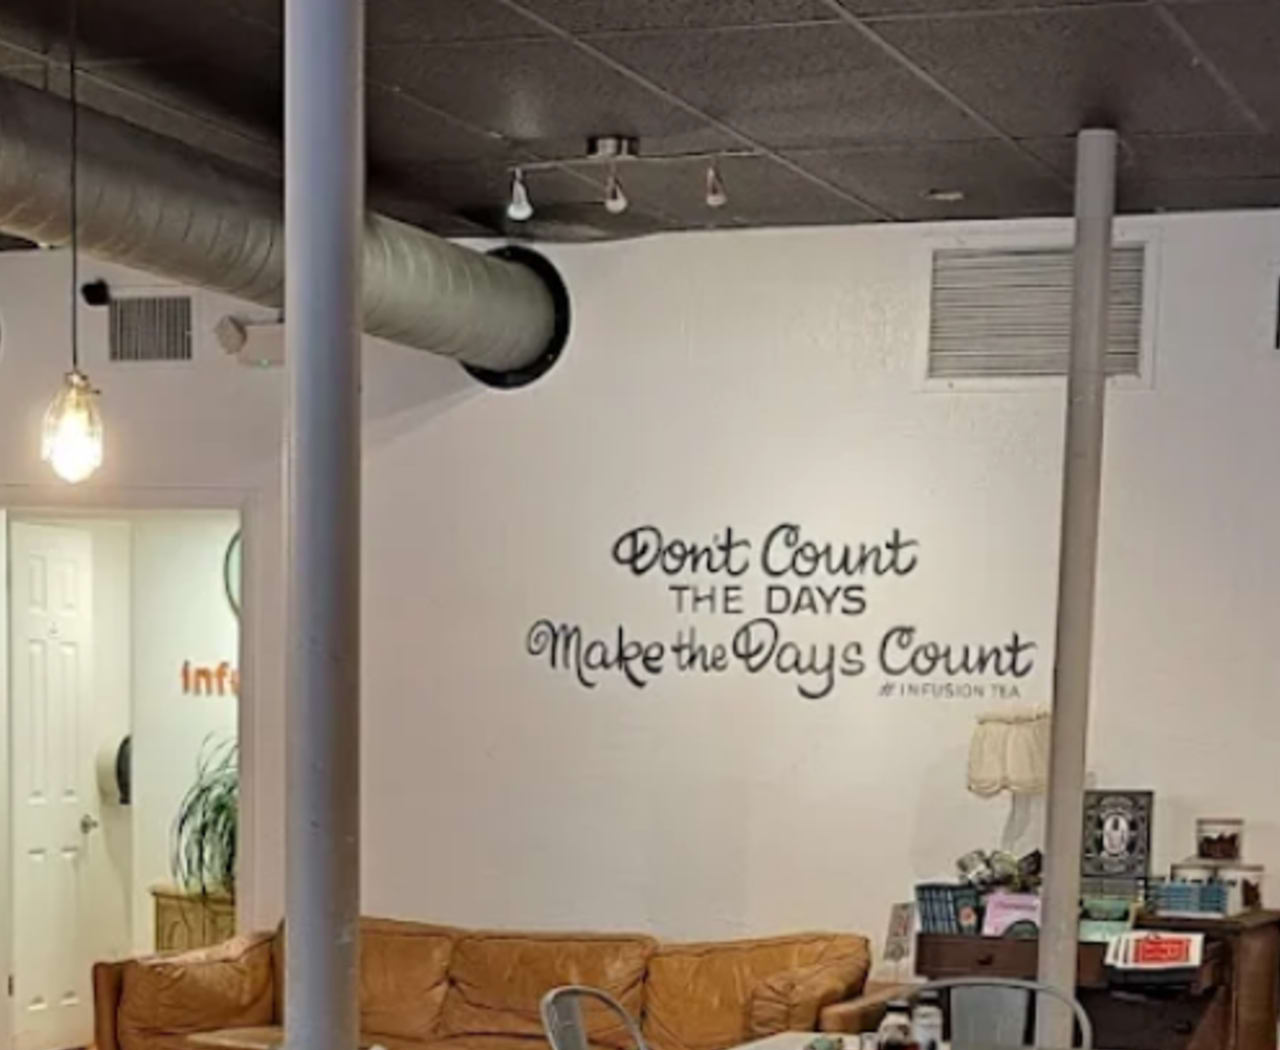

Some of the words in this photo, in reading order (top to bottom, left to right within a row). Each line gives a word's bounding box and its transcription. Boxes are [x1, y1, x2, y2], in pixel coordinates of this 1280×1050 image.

[761, 524, 918, 577] Count
[667, 585, 744, 614] THE
[765, 585, 866, 615] DAYS
[527, 618, 665, 688] Make
[671, 627, 728, 674] the
[732, 617, 866, 700] Days
[878, 626, 1038, 679] Count
[991, 682, 1022, 699] TEA
